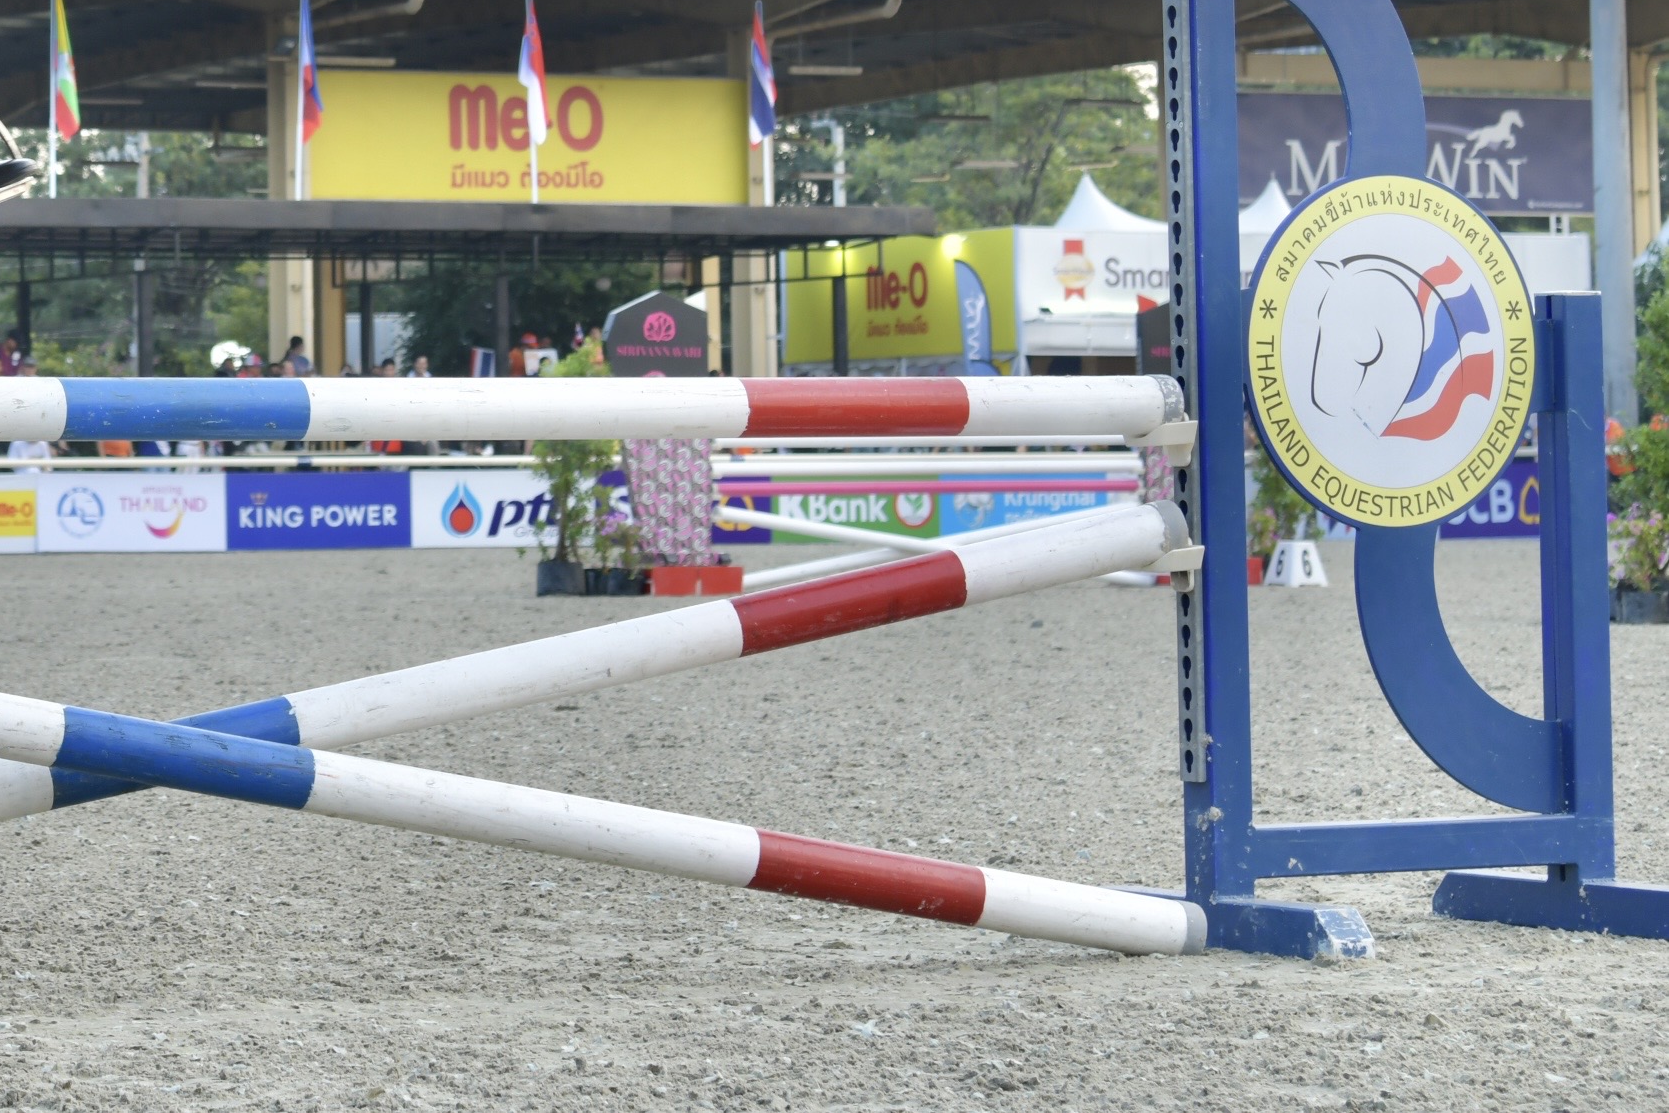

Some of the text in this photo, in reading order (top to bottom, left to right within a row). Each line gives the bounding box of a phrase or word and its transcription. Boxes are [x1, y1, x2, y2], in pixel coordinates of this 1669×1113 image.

[449, 84, 604, 153] MeO
[1276, 183, 1506, 286] สมาคมขี่ม้าแห่งประเทศไทย
[1256, 334, 1528, 518] THAILAND EQUESTRIAN FEDERATION
[120, 497, 208, 512] THAILAND
[238, 504, 398, 529] KING POWER
[778, 493, 889, 523] KBank
[1300, 549, 1313, 579] 6
